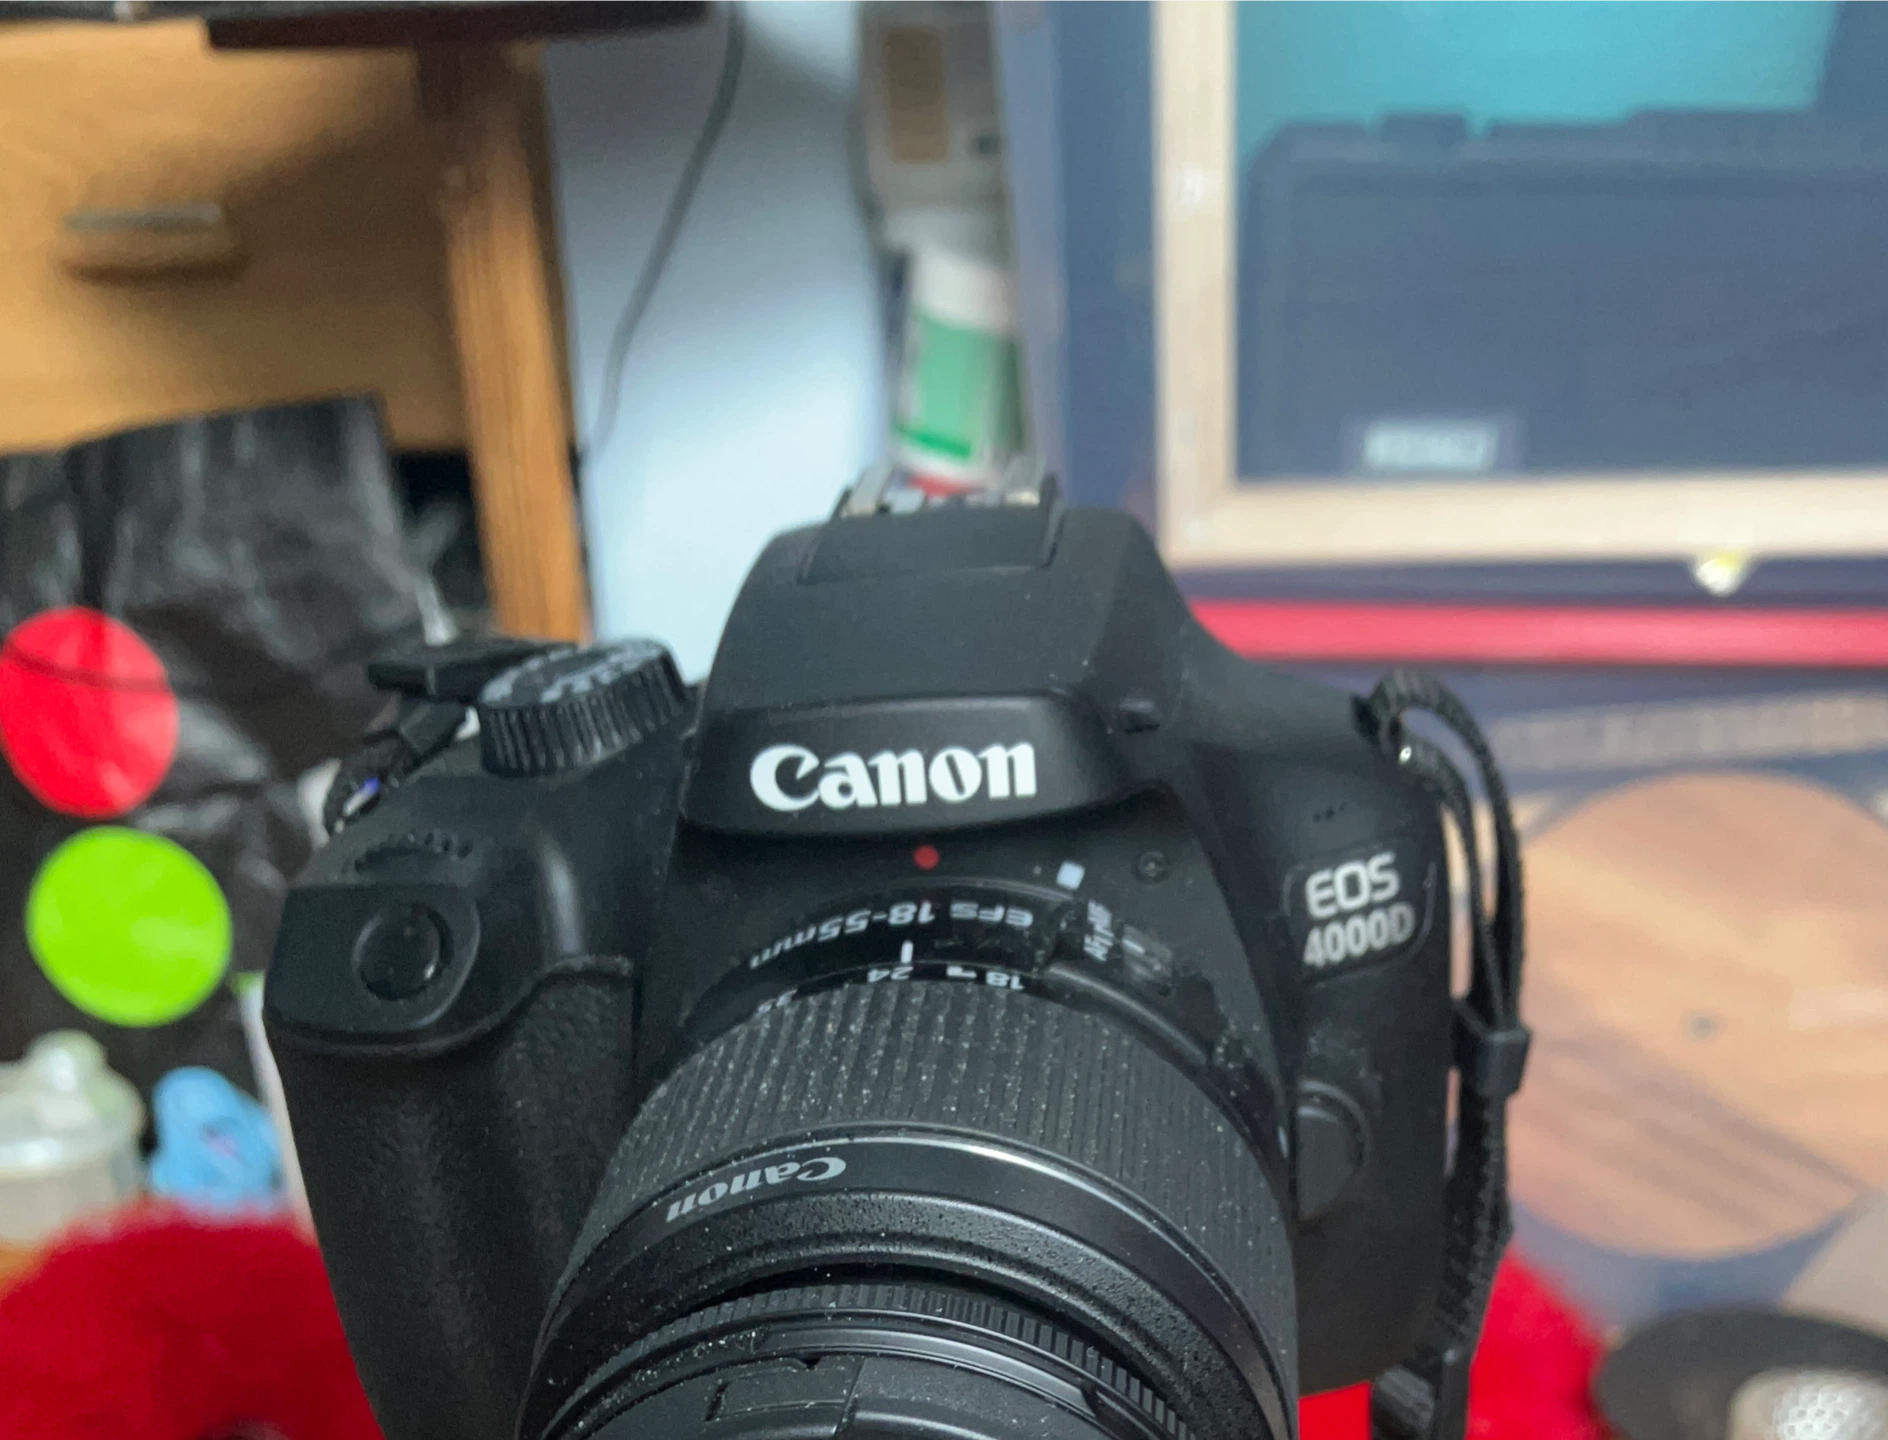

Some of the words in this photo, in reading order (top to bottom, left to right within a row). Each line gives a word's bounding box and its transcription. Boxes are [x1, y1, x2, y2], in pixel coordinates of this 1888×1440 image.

[750, 742, 1038, 812] Canon
[951, 902, 1034, 928] EFS
[1305, 851, 1400, 919] EOS
[749, 900, 936, 970] 18-55mm
[1303, 901, 1416, 968] 4000D
[866, 965, 914, 983] 24
[985, 970, 1025, 991] 18
[665, 1156, 848, 1223] Canon
